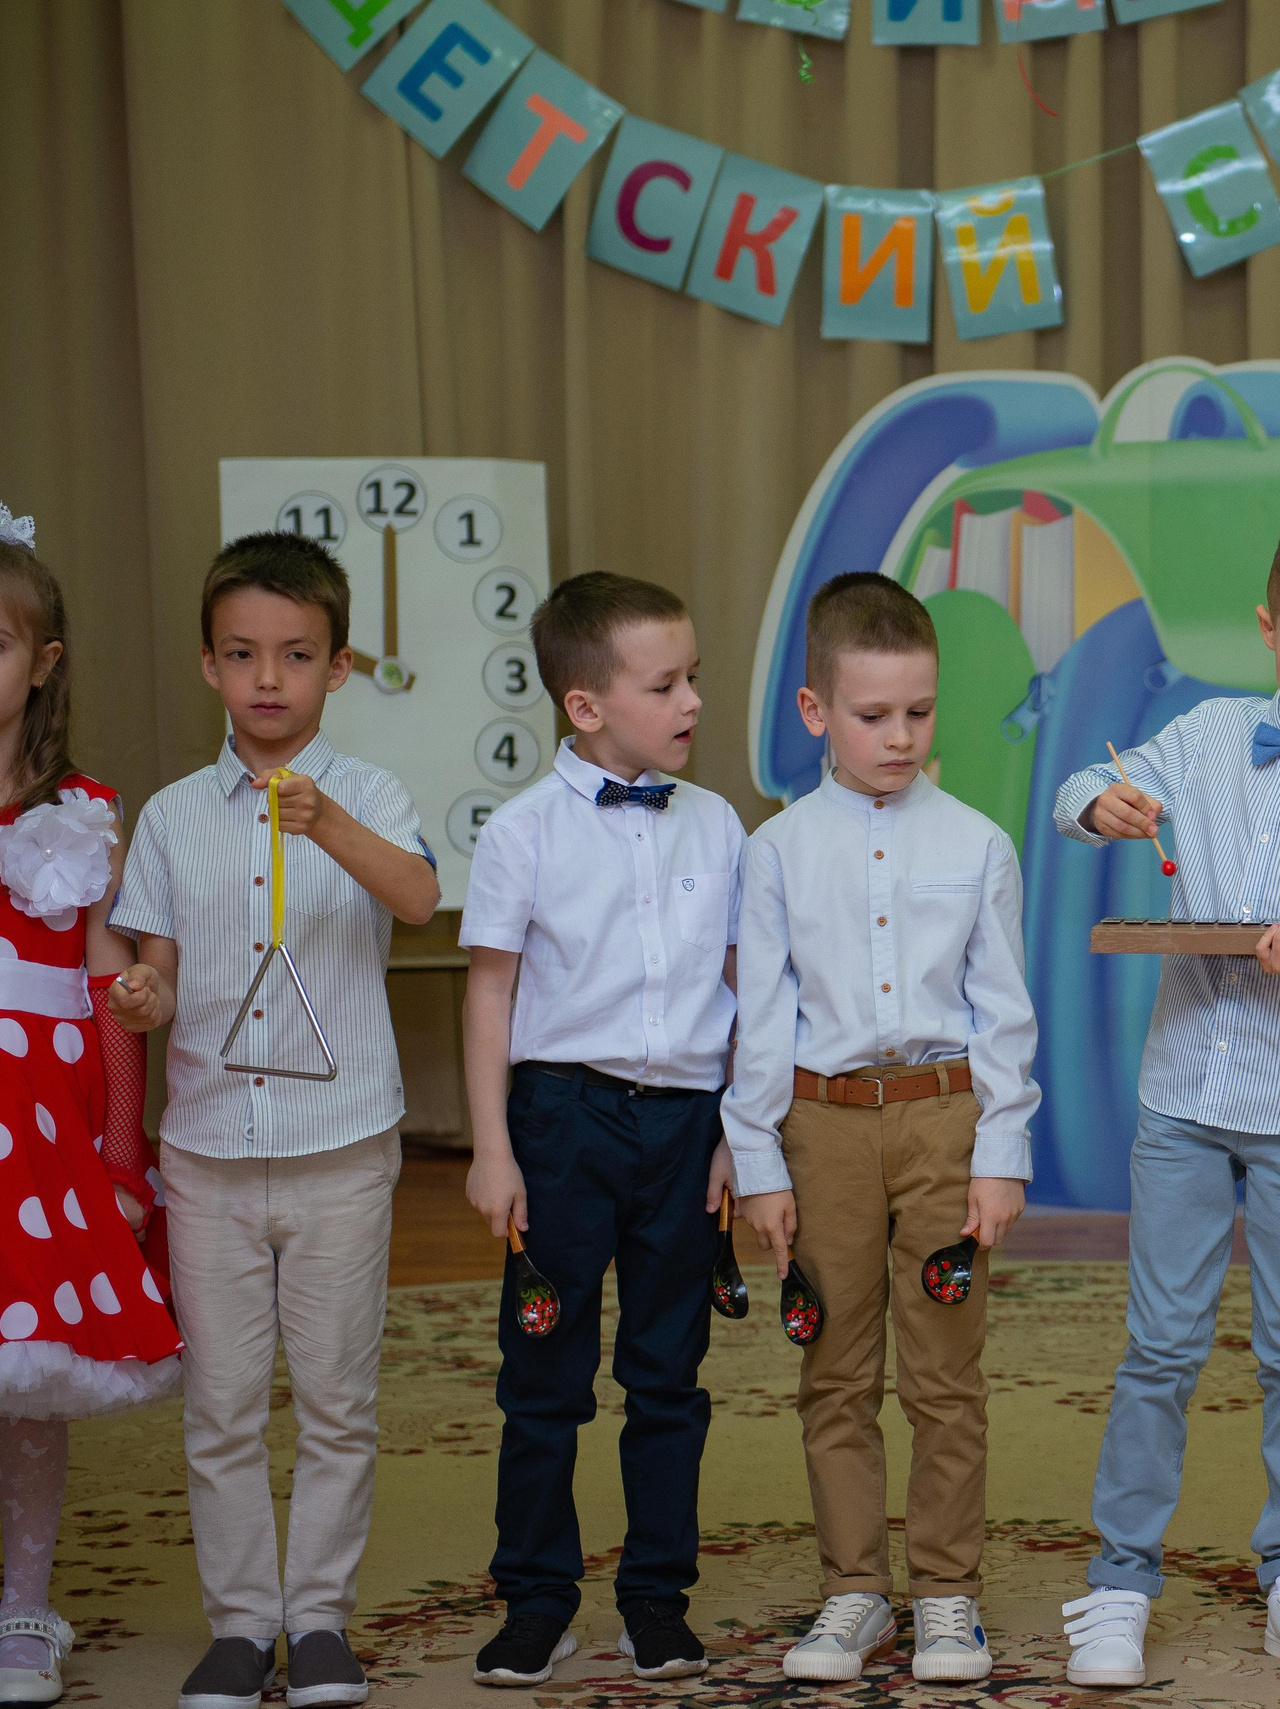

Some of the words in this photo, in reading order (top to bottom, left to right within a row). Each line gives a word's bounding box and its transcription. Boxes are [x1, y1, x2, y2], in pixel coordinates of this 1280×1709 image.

[365, 479, 419, 516] 12
[285, 505, 340, 541] 11
[457, 510, 482, 547] 1
[494, 582, 518, 622] 2
[505, 656, 528, 695] 3
[492, 732, 518, 772] 4
